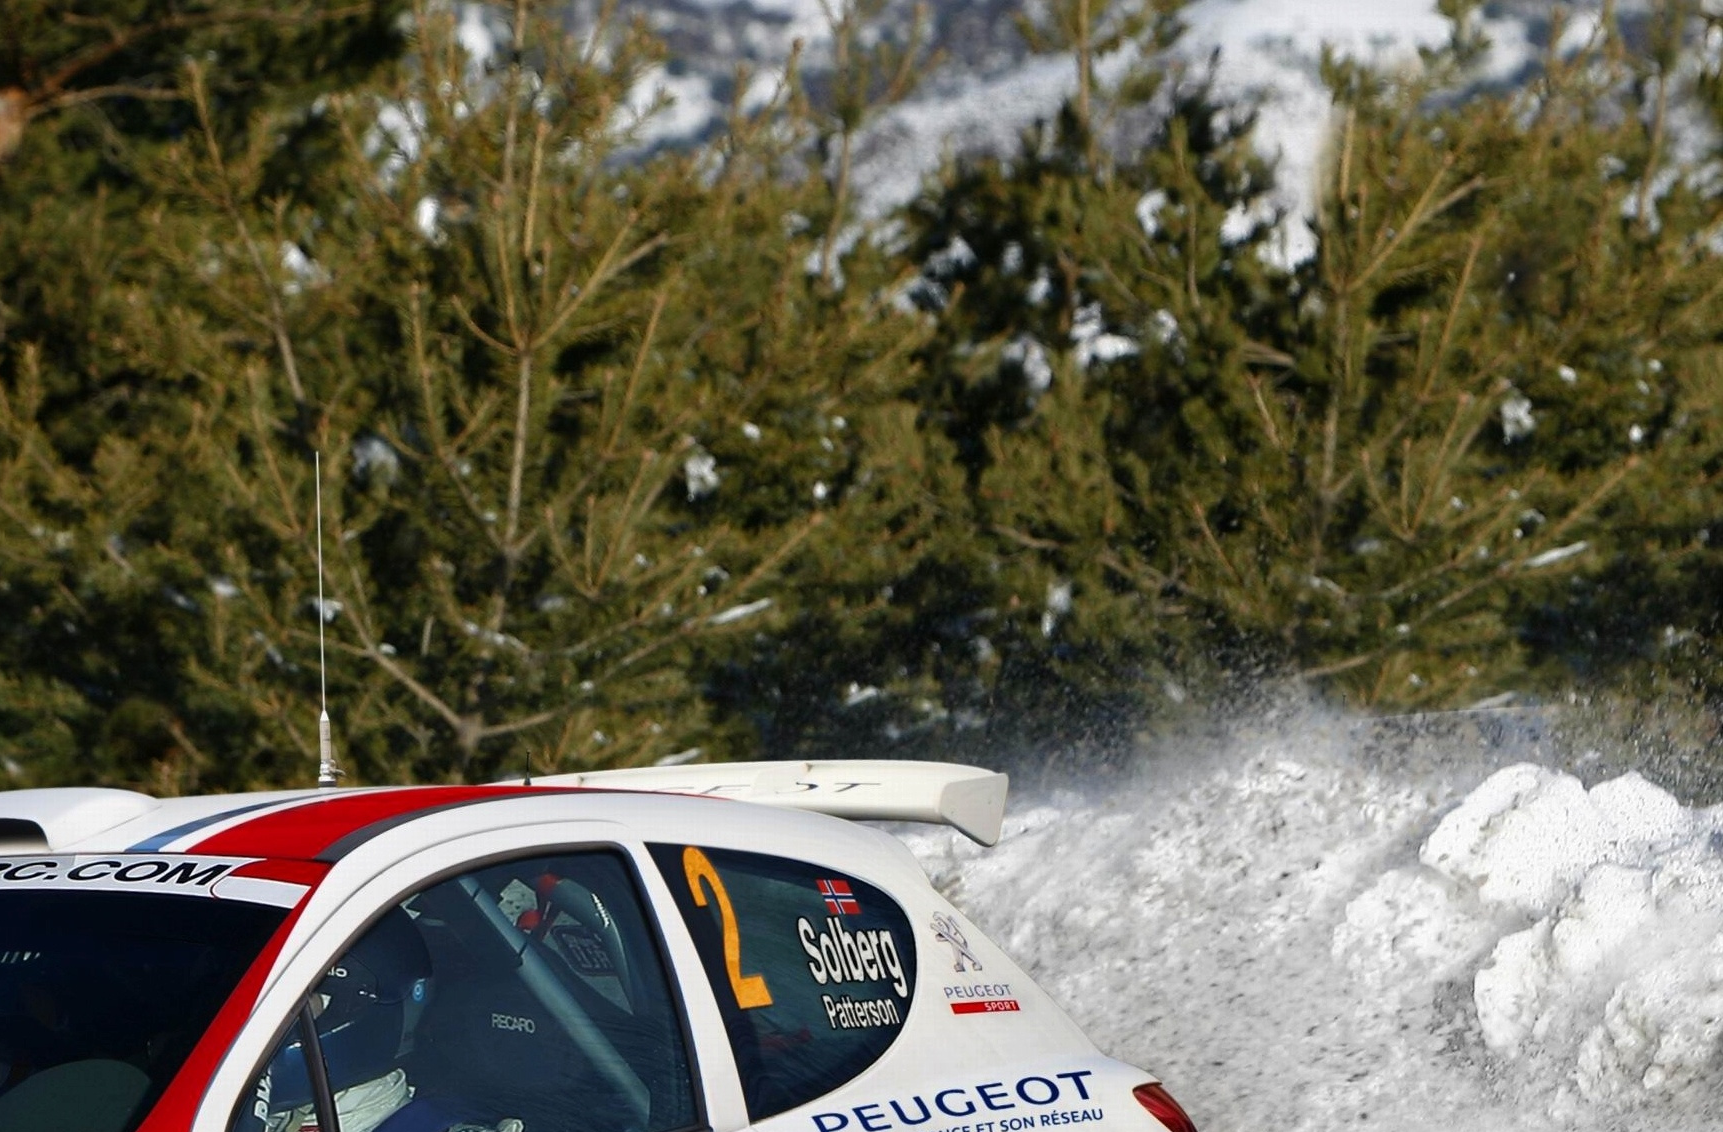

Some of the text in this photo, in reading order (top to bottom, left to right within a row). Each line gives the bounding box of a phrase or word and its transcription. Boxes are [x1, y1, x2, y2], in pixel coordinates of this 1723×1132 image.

[681, 845, 773, 1010] 2
[797, 916, 908, 999] Solberg
[943, 984, 1012, 999] PEUGEOT
[822, 994, 901, 1030] Patterson
[984, 1001, 1017, 1011] SPORT
[491, 1012, 536, 1034] RECARO
[1000, 1116, 1035, 1132] SON
[1040, 1108, 1104, 1127] RÉSEAU
